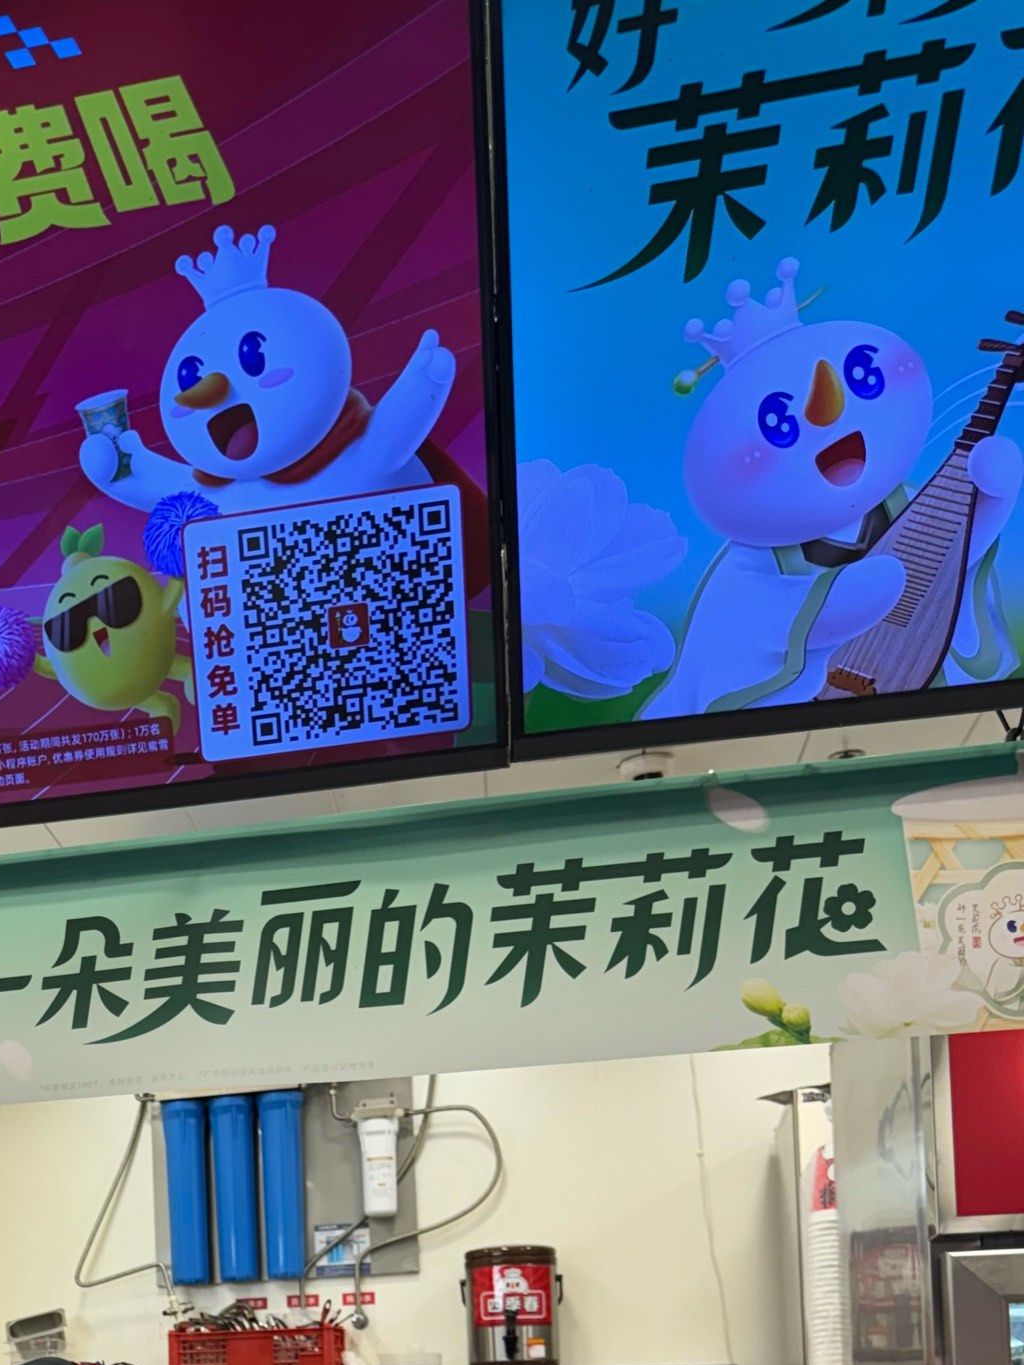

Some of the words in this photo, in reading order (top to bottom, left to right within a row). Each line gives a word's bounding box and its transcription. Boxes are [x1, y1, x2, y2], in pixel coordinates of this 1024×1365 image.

[197, 544, 242, 736] 扫码抢免单
